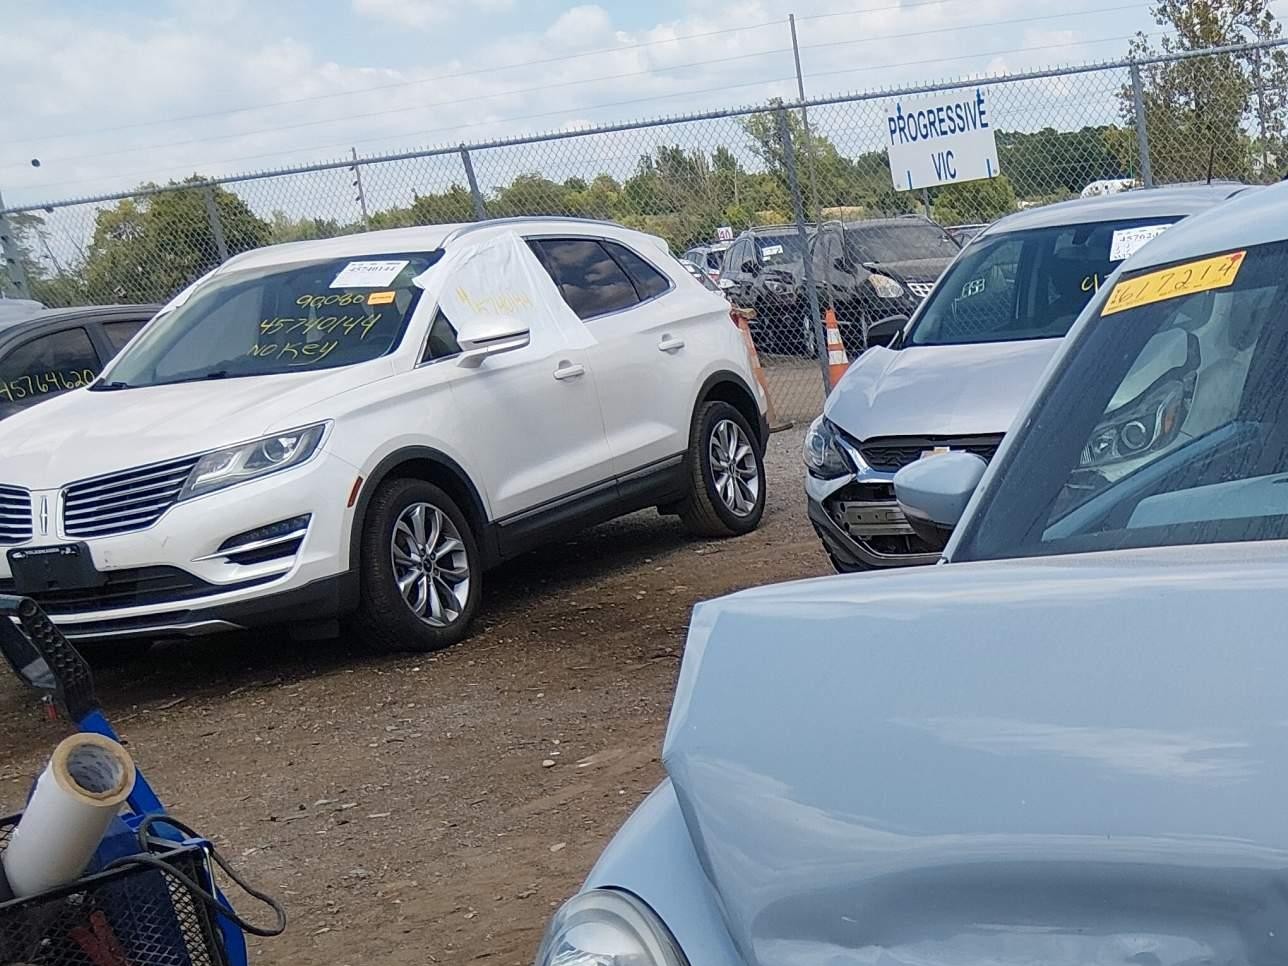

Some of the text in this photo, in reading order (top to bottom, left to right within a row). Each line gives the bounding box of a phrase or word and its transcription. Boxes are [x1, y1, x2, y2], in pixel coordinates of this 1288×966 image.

[887, 97, 989, 145] PROGRESSIVE
[931, 150, 957, 181] VIC
[0, 369, 96, 401] 45764620
